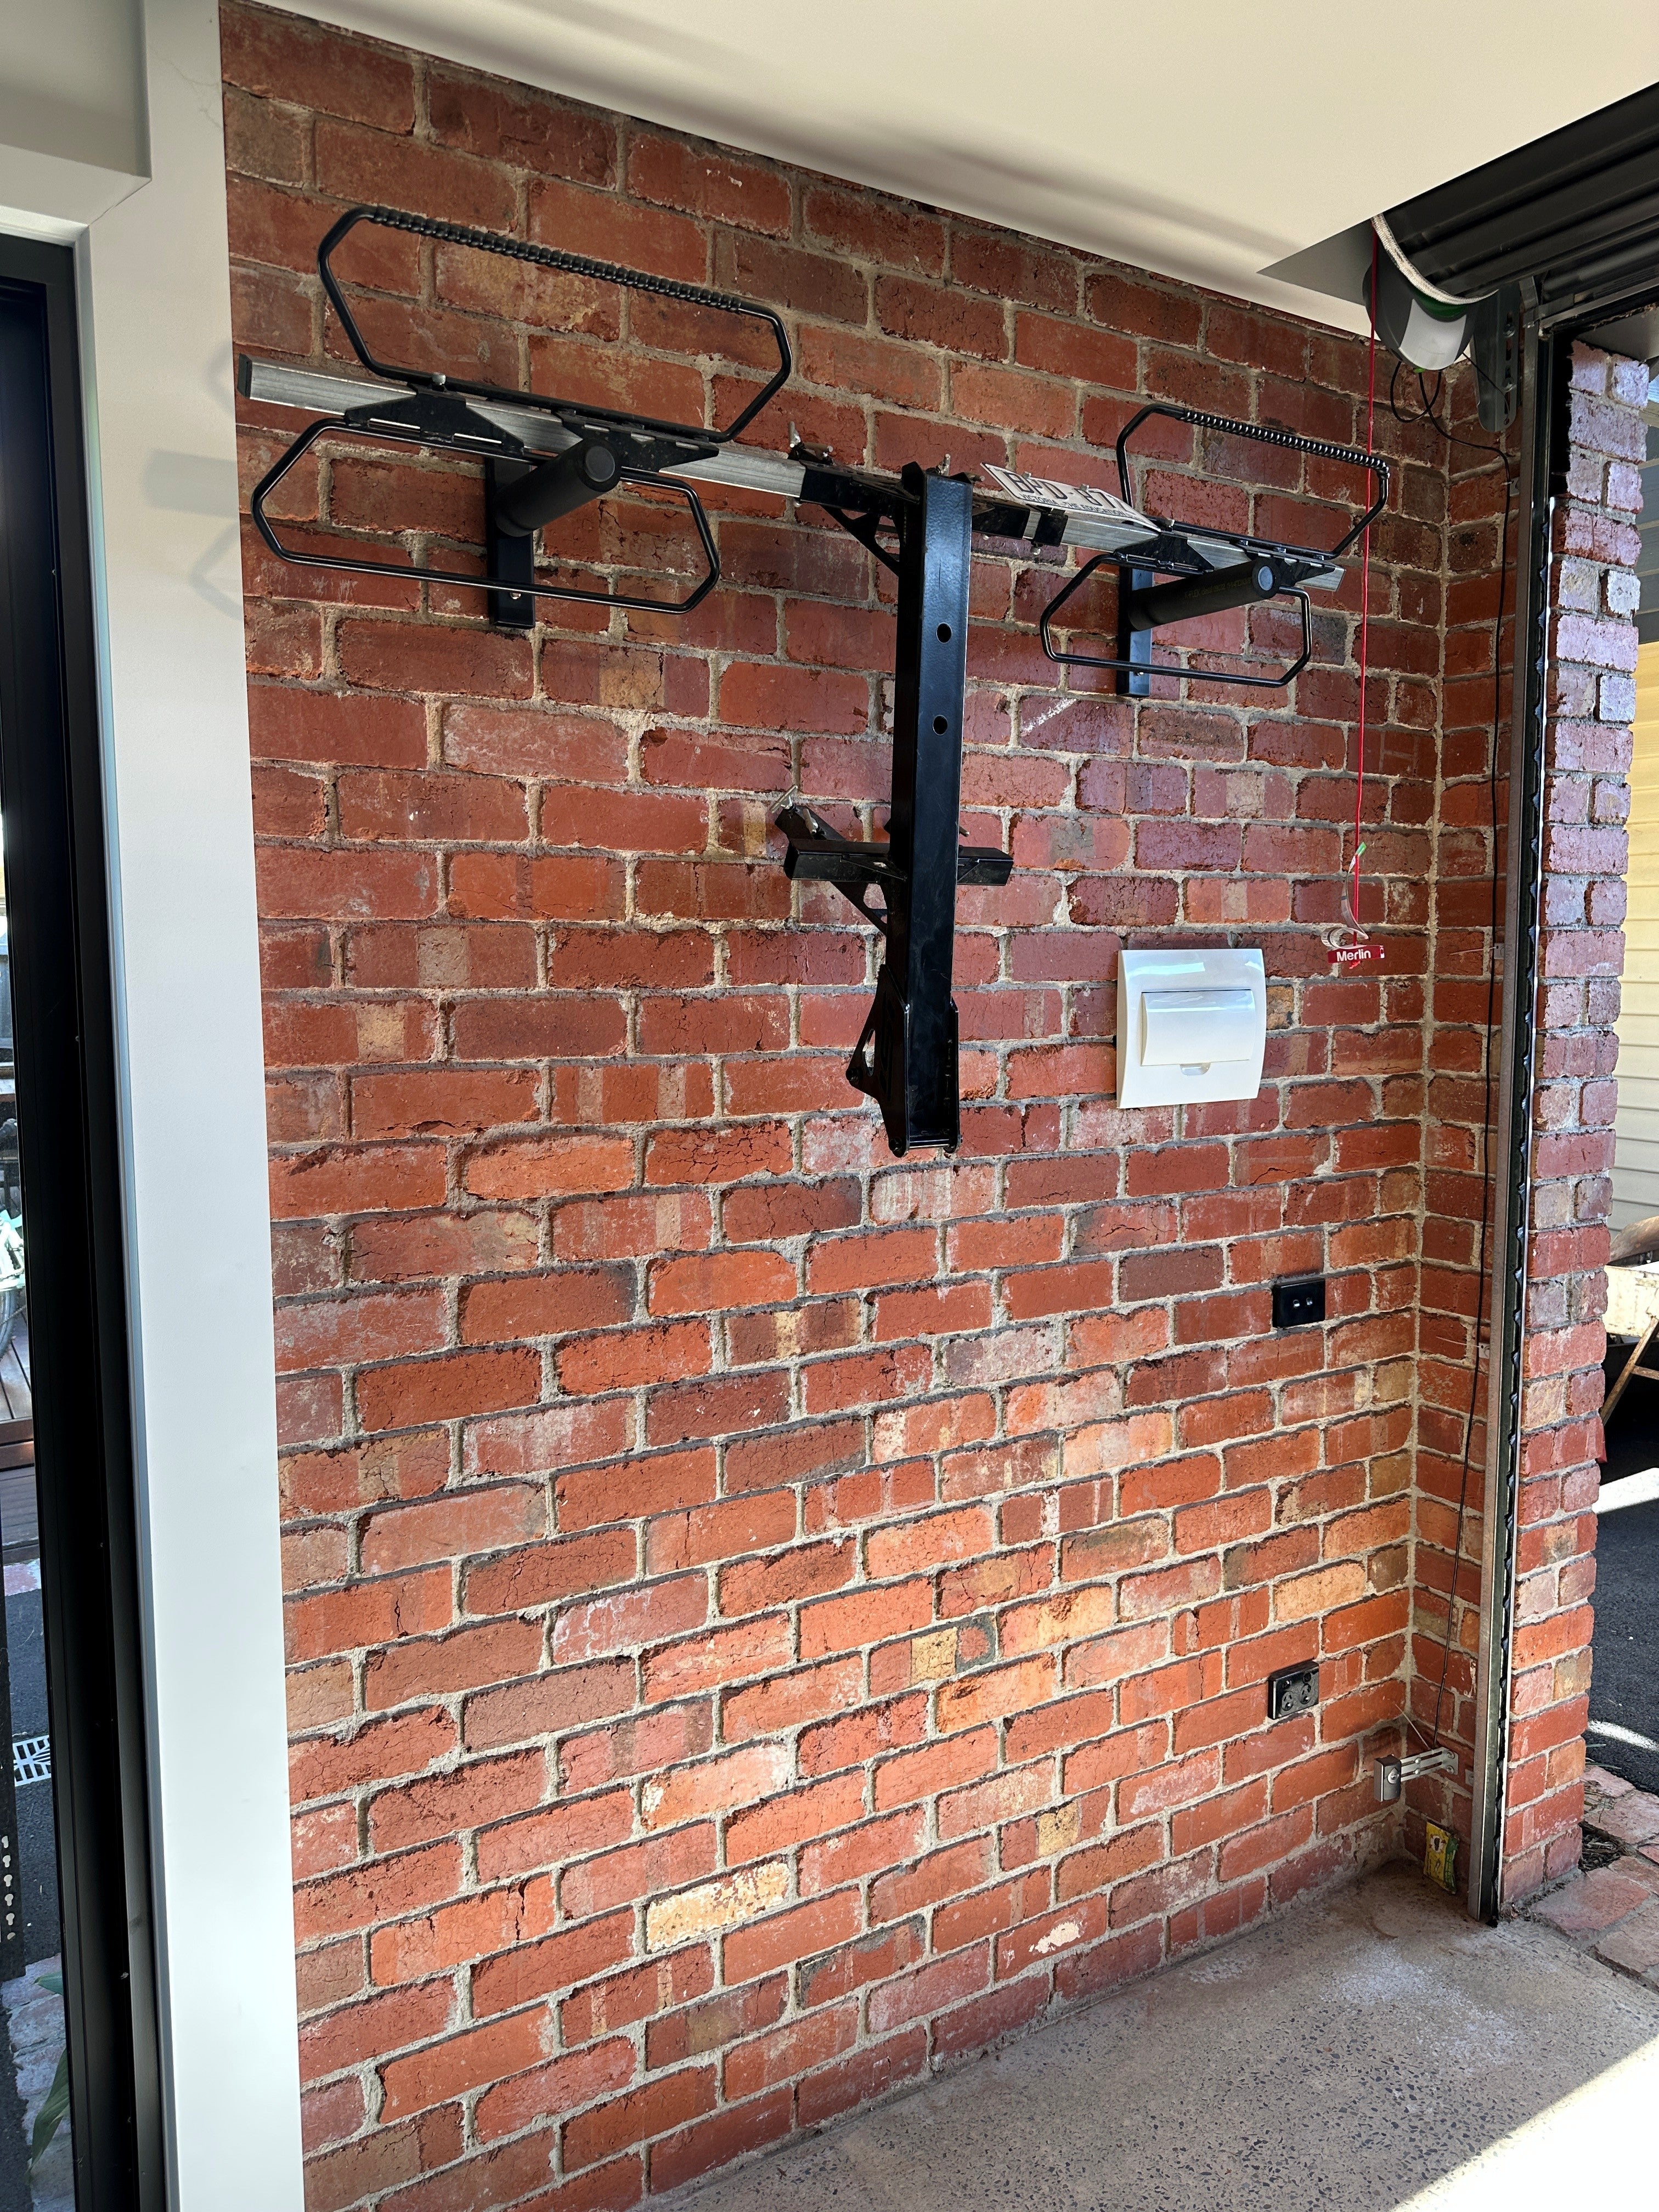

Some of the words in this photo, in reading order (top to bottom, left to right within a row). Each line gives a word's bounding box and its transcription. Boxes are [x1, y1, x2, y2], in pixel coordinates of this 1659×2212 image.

[1019, 494, 1060, 506] VICTORIA
[1080, 504, 1126, 516] EDUCATION
[1336, 949, 1371, 962] Merlin
